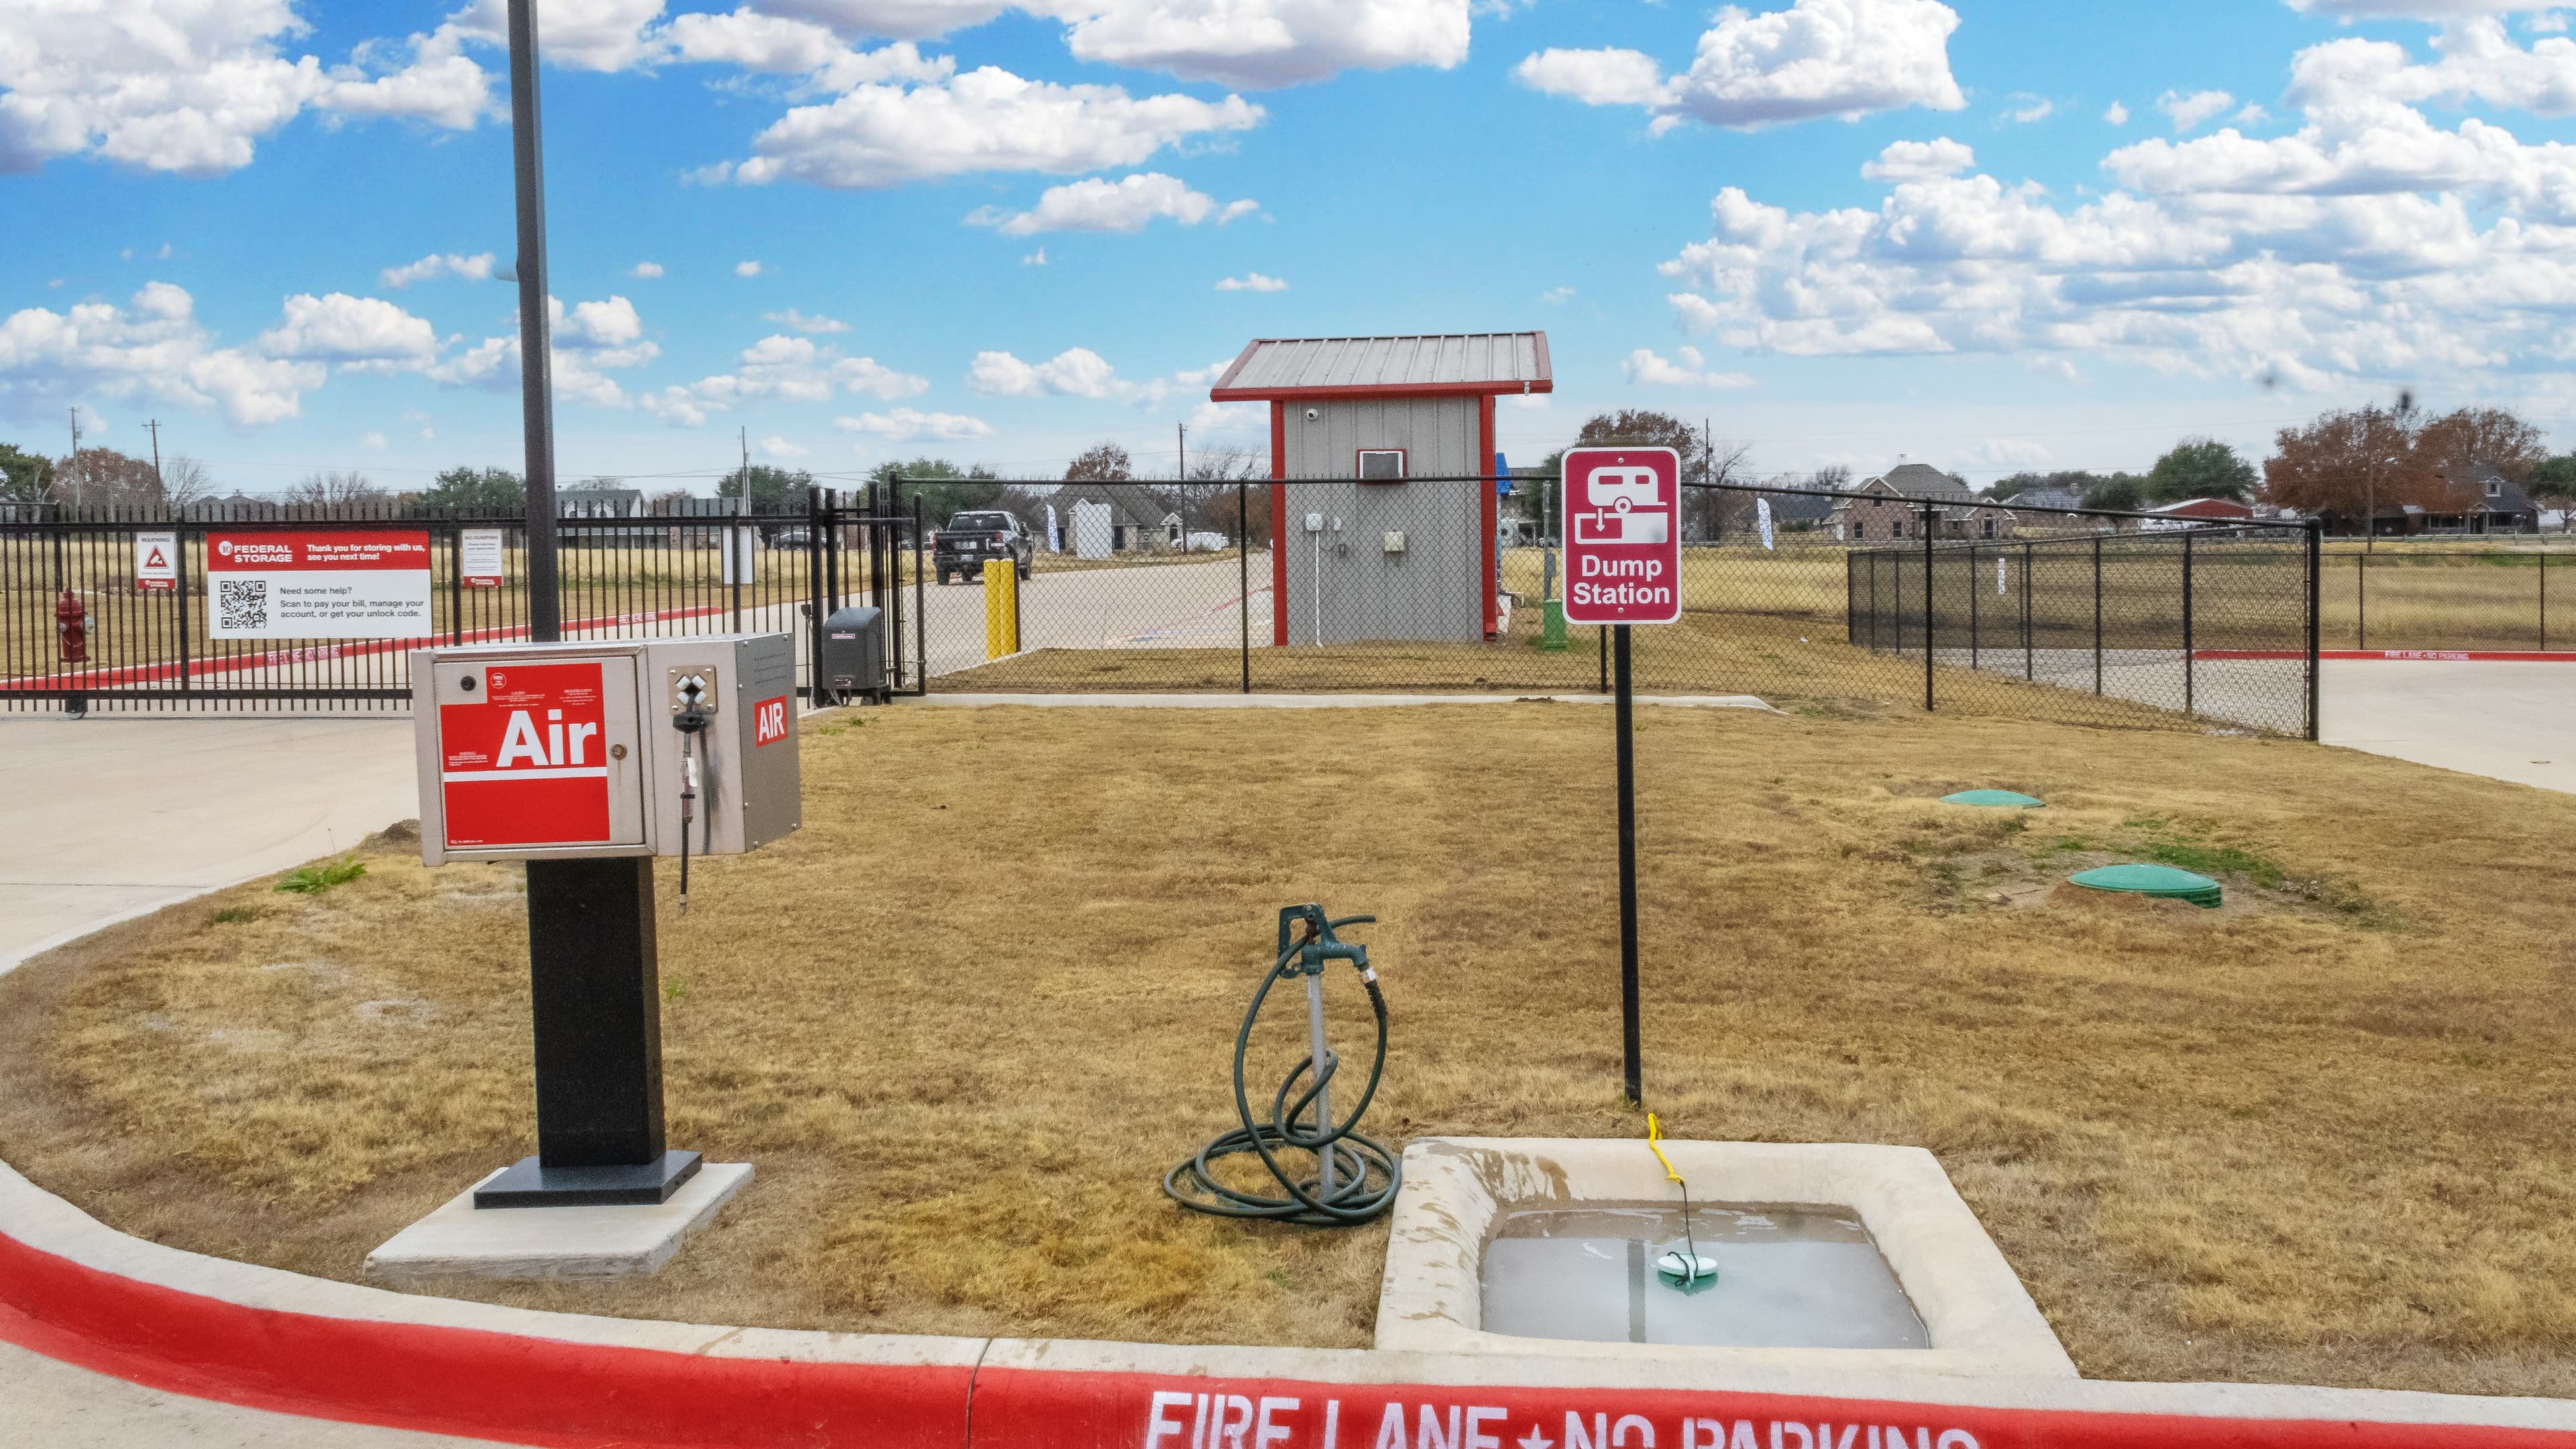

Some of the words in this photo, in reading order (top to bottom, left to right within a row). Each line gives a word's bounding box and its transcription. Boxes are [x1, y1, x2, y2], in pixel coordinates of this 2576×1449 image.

[234, 545, 292, 553] FEDERAL
[307, 544, 333, 552] Thank
[333, 545, 349, 553] you
[350, 544, 362, 552] for
[363, 543, 392, 553] storing
[394, 543, 411, 551] with
[413, 545, 425, 553] us,
[235, 554, 292, 563] STORAGE
[323, 554, 339, 562] you
[340, 553, 358, 561] next
[360, 553, 380, 561] time!
[1581, 554, 1662, 582] Dump
[280, 587, 302, 595] Need
[329, 586, 352, 596] help?
[1573, 582, 1670, 604] Station
[280, 600, 301, 608] Scan
[352, 600, 367, 608] bill,
[370, 601, 403, 609] manage
[330, 611, 343, 619] get
[2438, 653, 2469, 661] PARKING
[758, 702, 785, 742] AIR
[496, 708, 597, 767] Air
[1144, 1391, 1300, 1449] FIRE
